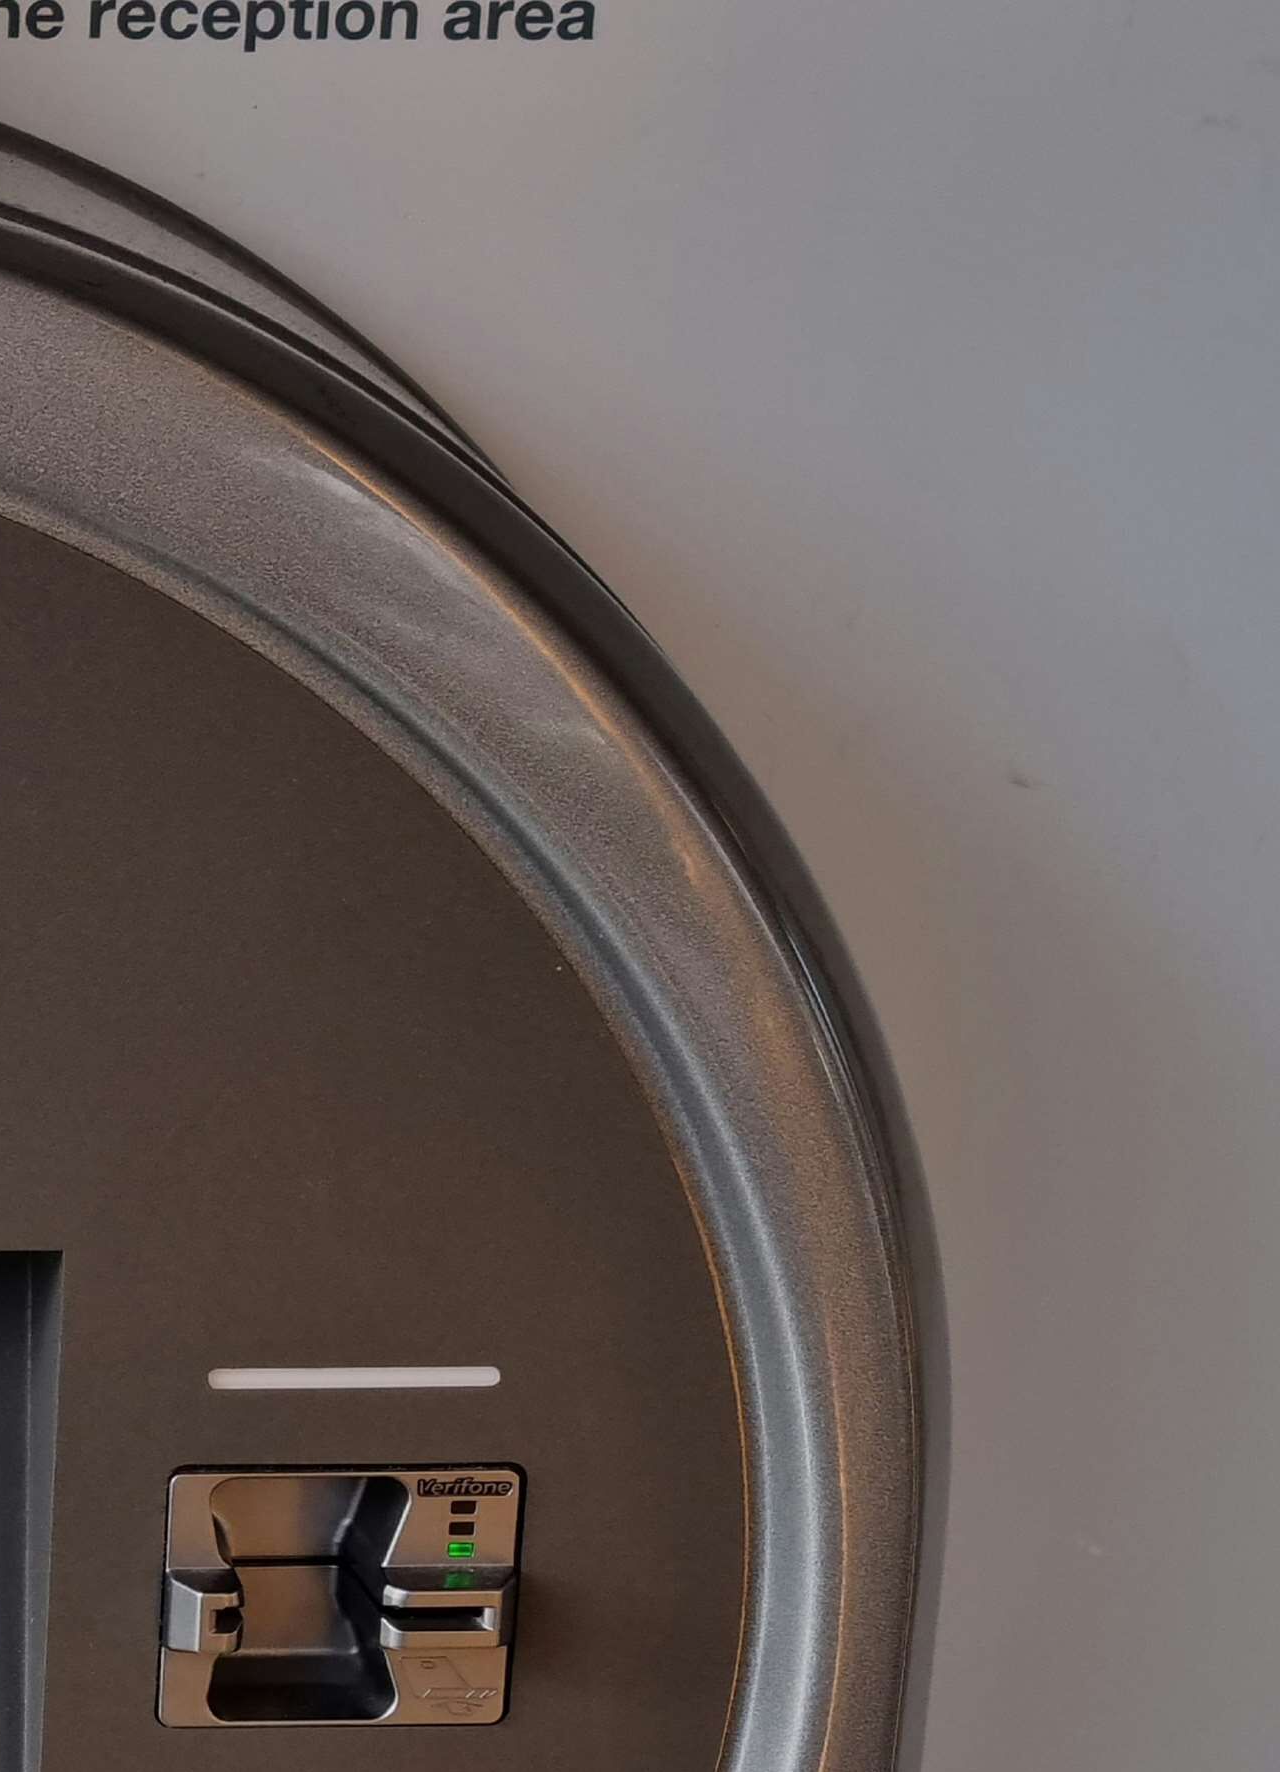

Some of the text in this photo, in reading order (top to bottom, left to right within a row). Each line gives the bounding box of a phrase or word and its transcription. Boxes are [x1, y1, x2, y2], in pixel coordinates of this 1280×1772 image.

[88, 0, 419, 53] reception
[442, 0, 595, 41] area
[418, 1478, 512, 1496] Verifone
